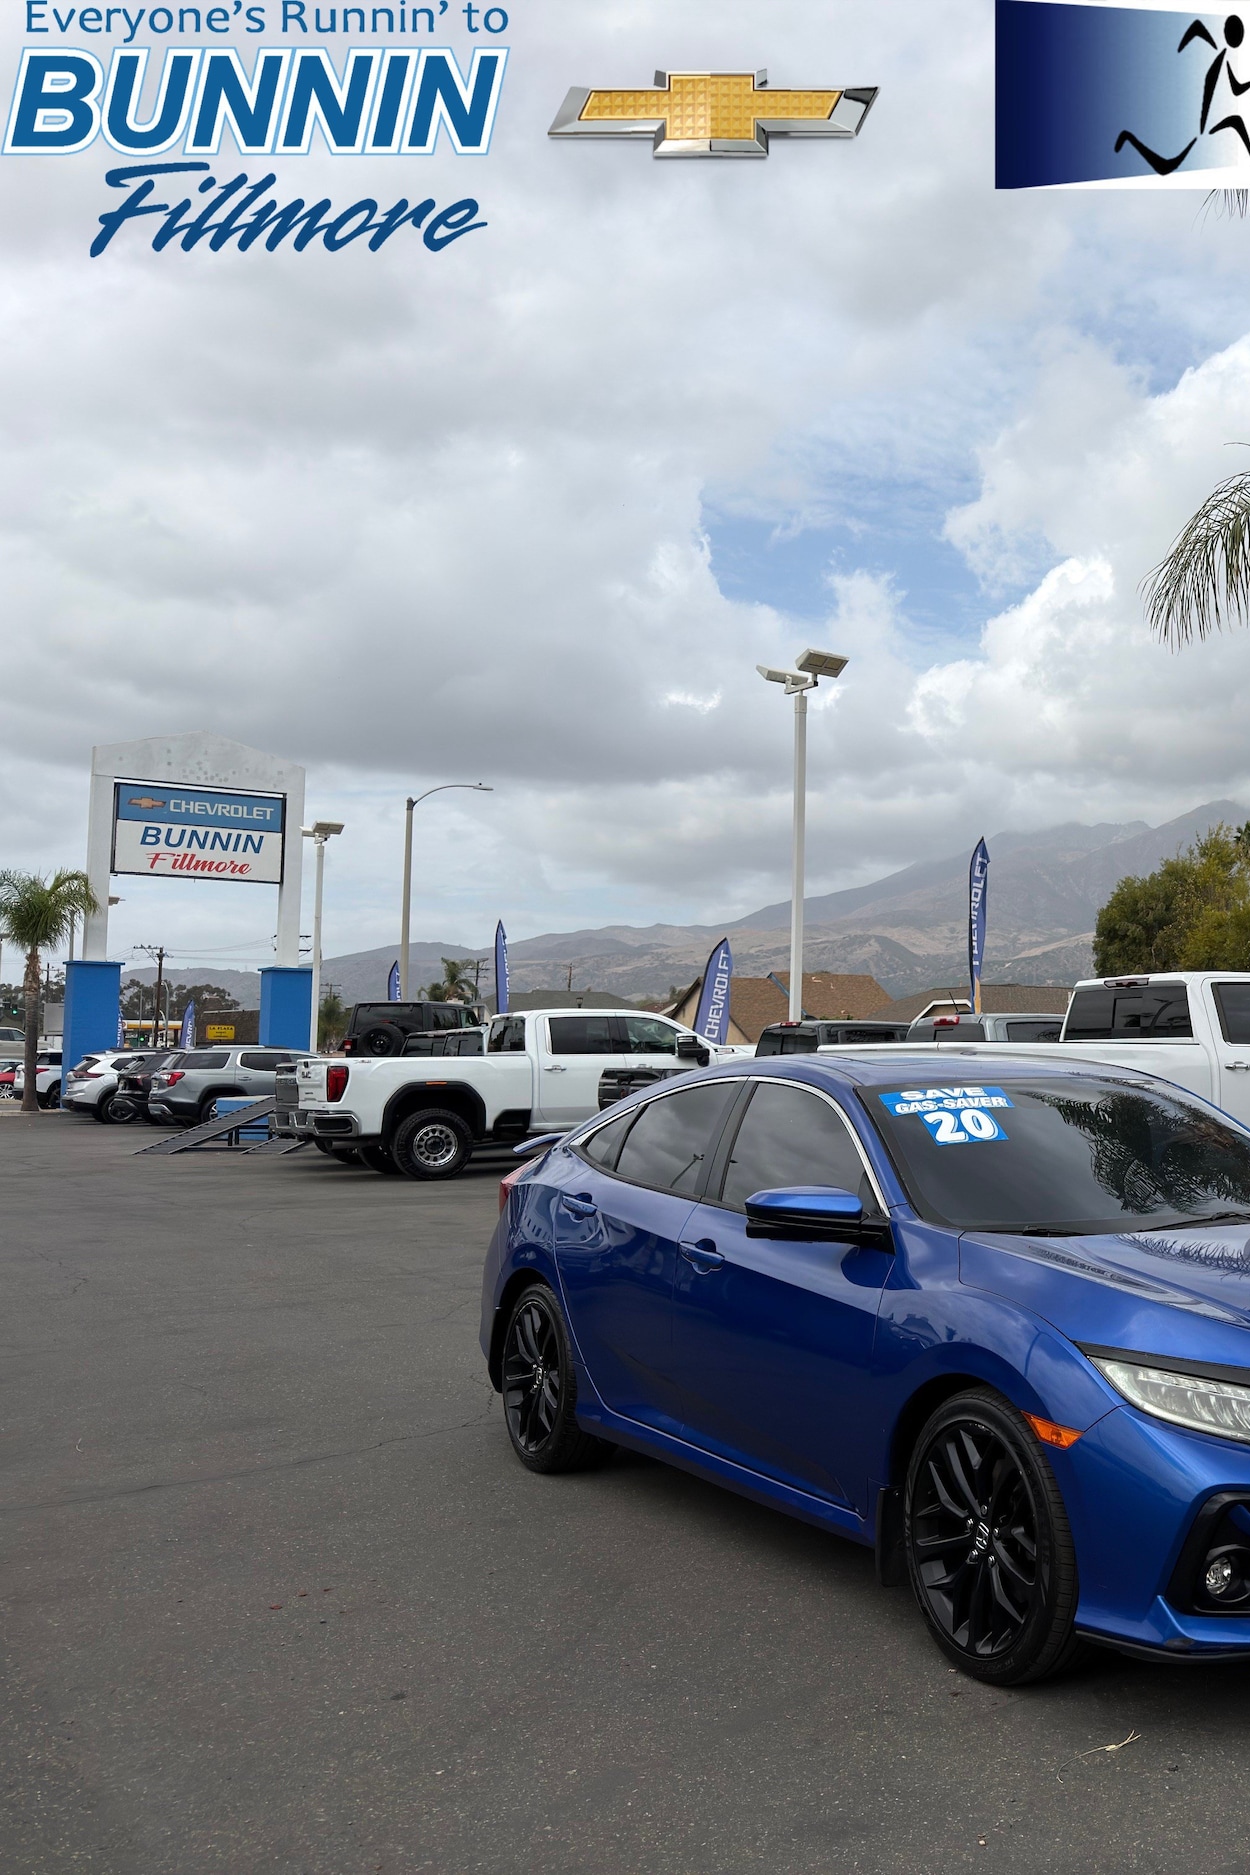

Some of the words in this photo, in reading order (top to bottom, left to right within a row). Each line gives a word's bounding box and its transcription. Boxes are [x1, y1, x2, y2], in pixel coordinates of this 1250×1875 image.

[169, 799, 275, 821] CHEVROLET
[140, 826, 264, 854] BUNNIN
[145, 851, 252, 875] Fillmore
[895, 1096, 1007, 1114] GAS-SAVER
[900, 1086, 987, 1102] SAVE
[923, 1108, 999, 1143] 20
